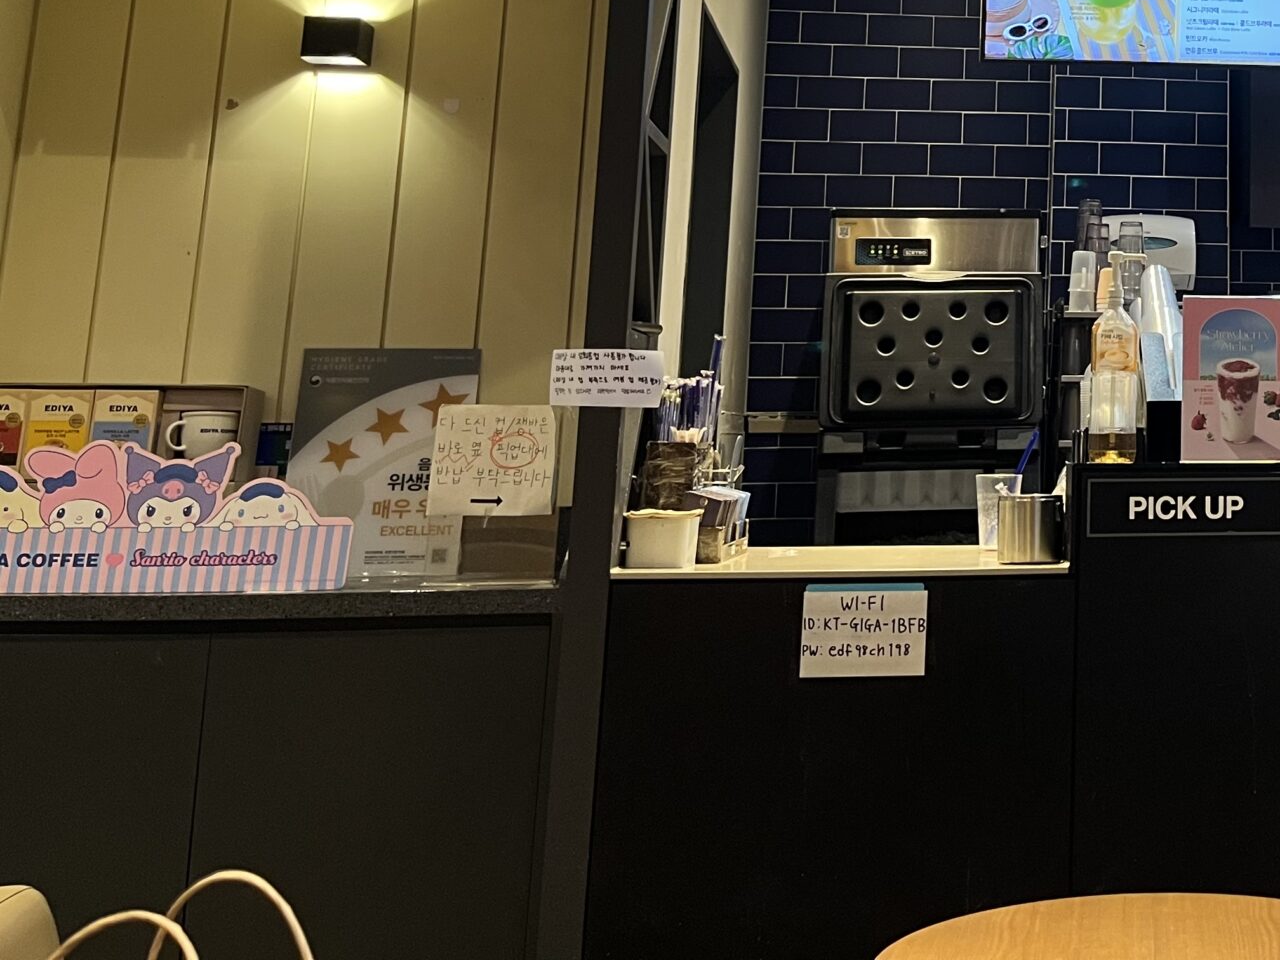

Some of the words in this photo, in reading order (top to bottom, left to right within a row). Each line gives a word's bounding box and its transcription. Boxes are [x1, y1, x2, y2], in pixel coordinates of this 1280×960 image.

[44, 404, 74, 412] EDIYA
[109, 404, 138, 412] EDIYA
[439, 416, 455, 430] 다
[461, 418, 486, 435] 드신
[438, 440, 463, 455] 바로
[436, 465, 464, 485] 반납
[472, 468, 551, 487] 부탁드립니다
[371, 499, 411, 519] 매우
[1128, 495, 1198, 520] PICK
[1205, 495, 1244, 520] UP
[380, 524, 454, 537] EXCELLENT
[16, 552, 99, 568] COFFEE
[130, 548, 187, 567] Sanrio
[189, 550, 278, 567] characters
[840, 594, 885, 611] WI-FI
[802, 644, 823, 656] PW:
